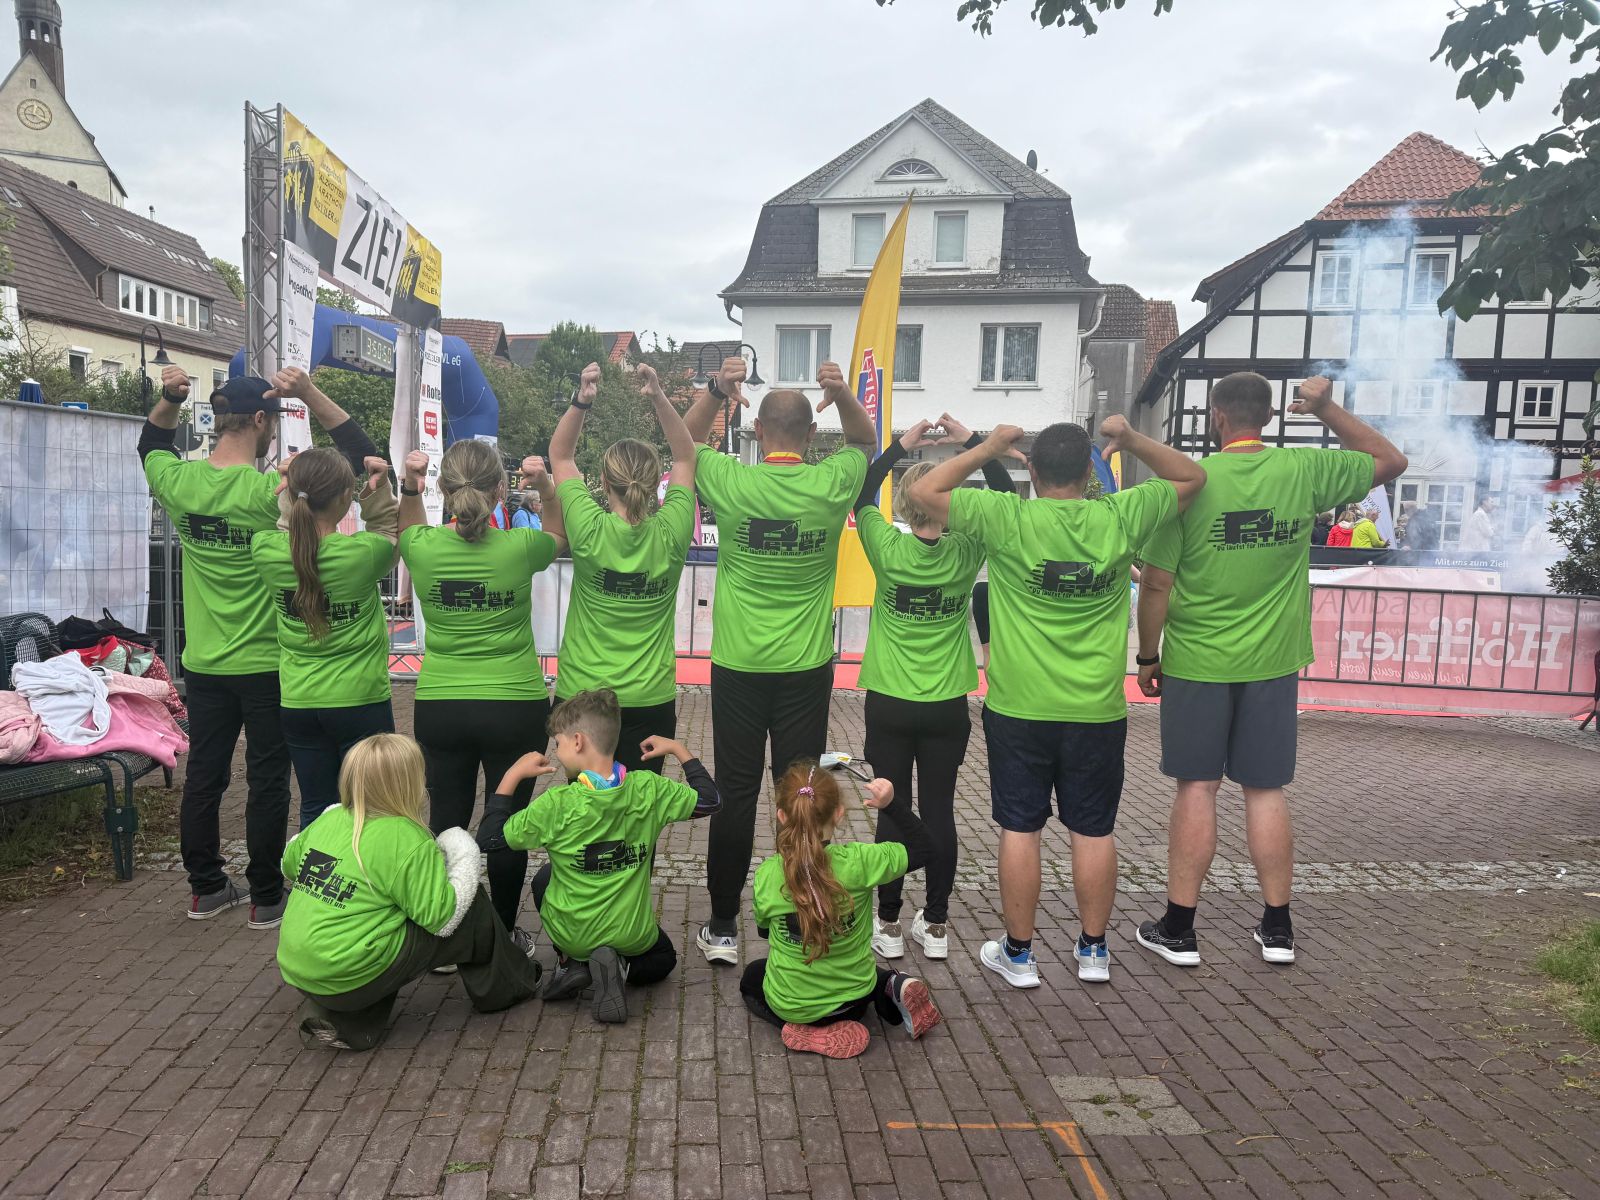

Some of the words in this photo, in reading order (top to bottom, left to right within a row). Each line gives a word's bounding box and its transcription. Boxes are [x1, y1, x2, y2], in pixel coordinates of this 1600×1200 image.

[1434, 558, 1451, 566] Mit
[321, 896, 333, 905] mit
[334, 901, 347, 910] uns
